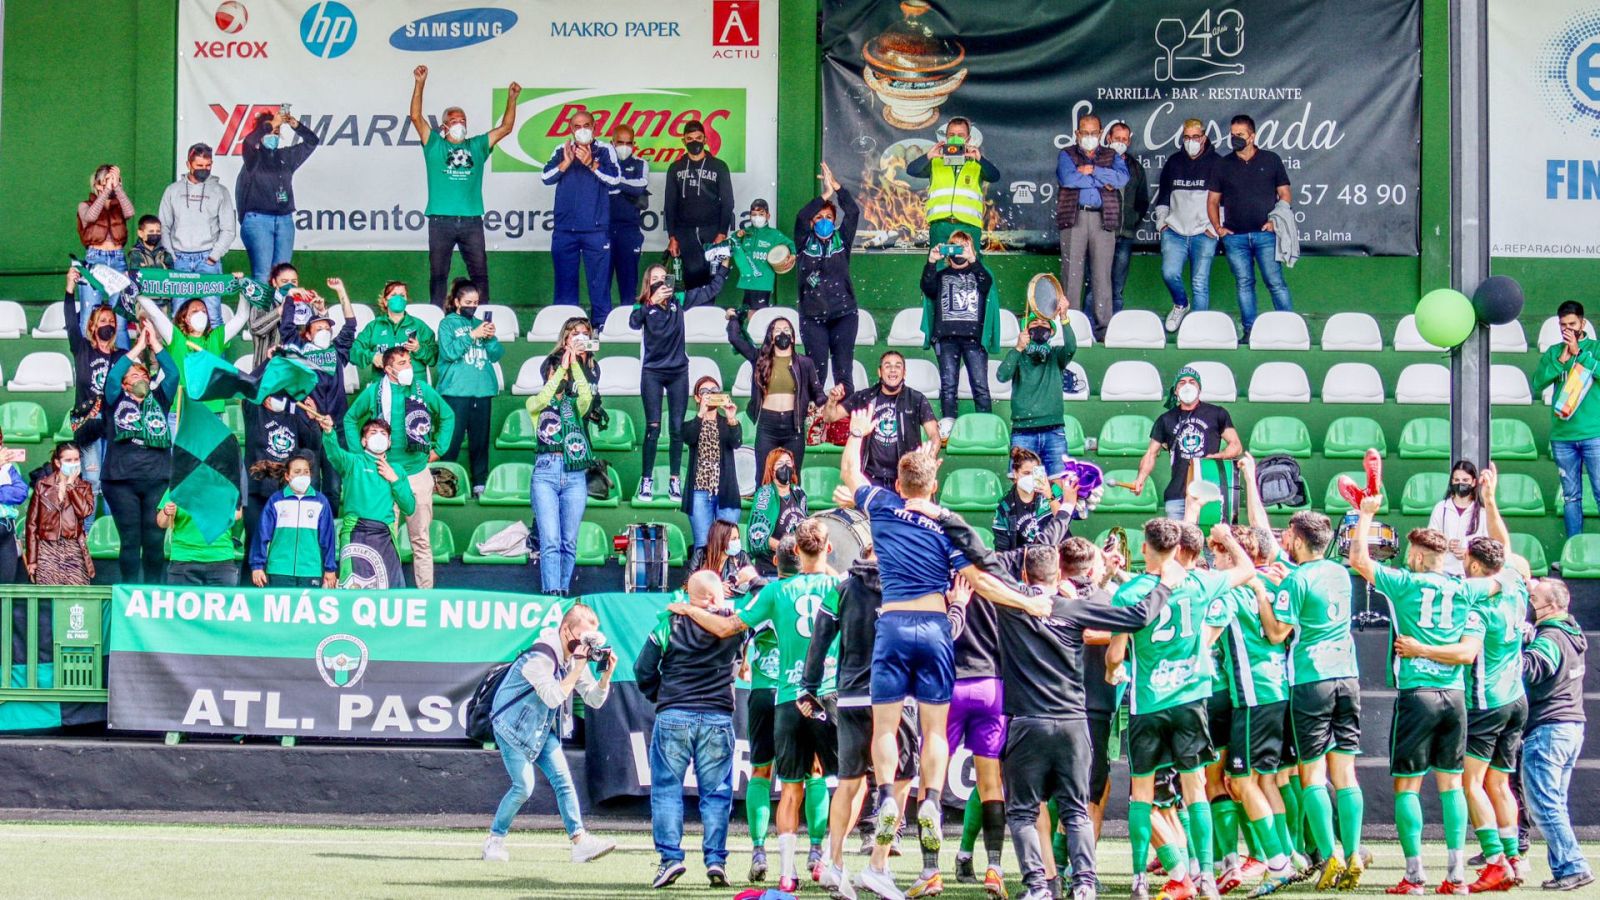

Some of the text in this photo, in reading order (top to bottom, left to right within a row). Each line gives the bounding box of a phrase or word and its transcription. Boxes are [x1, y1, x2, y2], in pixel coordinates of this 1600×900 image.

[306, 2, 352, 58] hp
[405, 22, 502, 38] SAMSUNG
[550, 22, 681, 37] MAKRO PAPER
[193, 40, 268, 58] xerox
[712, 49, 760, 59] ACTIU
[1097, 87, 1302, 100] PARRILLA BAR RESTAURANTE
[1143, 102, 1345, 151] Casada
[1173, 179, 1206, 187] RELEASE
[1299, 184, 1328, 205] 57
[1337, 184, 1367, 205] 48
[1377, 184, 1407, 205] 90
[1315, 229, 1352, 241] Palma
[143, 279, 224, 295] ATLÉTICO PASO
[125, 588, 562, 630] AHORA MÁS QUE NUNCA
[1417, 586, 1455, 629] 11
[1150, 597, 1194, 643] 21
[181, 688, 315, 731] ATL.
